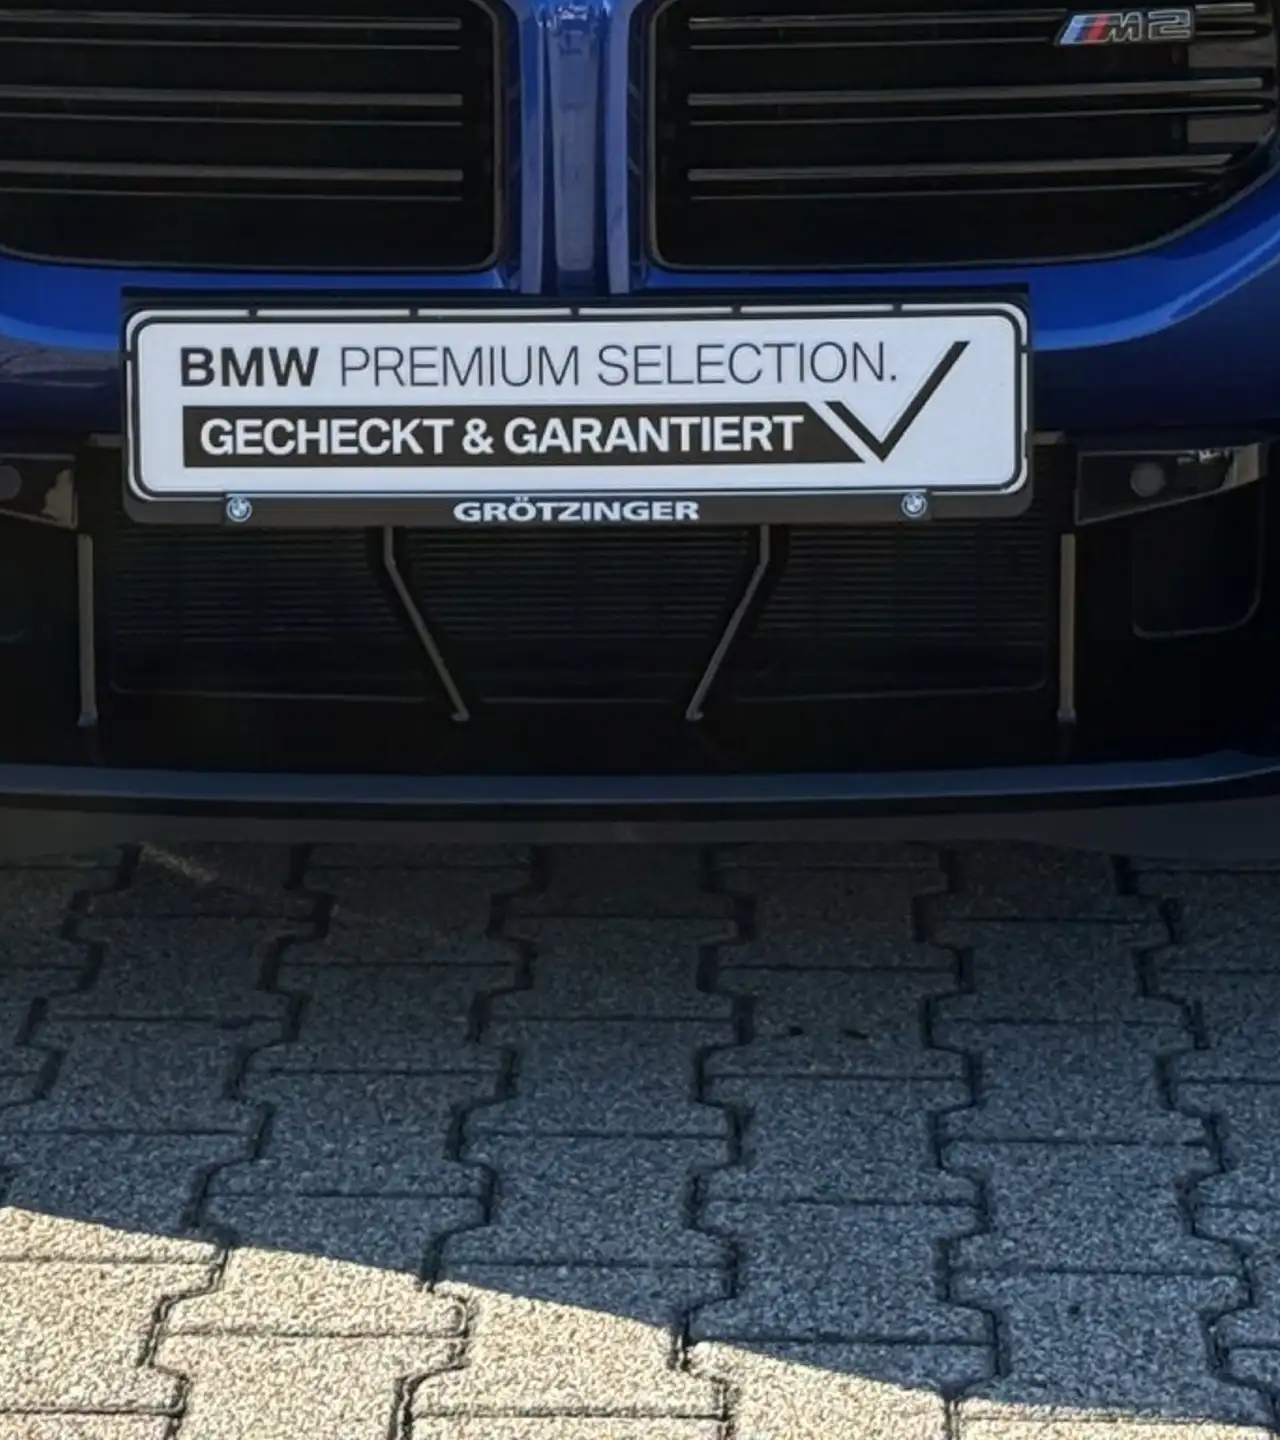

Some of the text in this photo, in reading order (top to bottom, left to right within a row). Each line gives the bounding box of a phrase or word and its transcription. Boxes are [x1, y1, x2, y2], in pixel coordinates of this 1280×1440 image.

[1082, 9, 1192, 43] M2
[180, 341, 897, 388] BMW PREMIUM SELECTION.
[200, 414, 805, 456] GECHECKT & GARANTIERT
[452, 496, 700, 523] GRÖTZINGER
